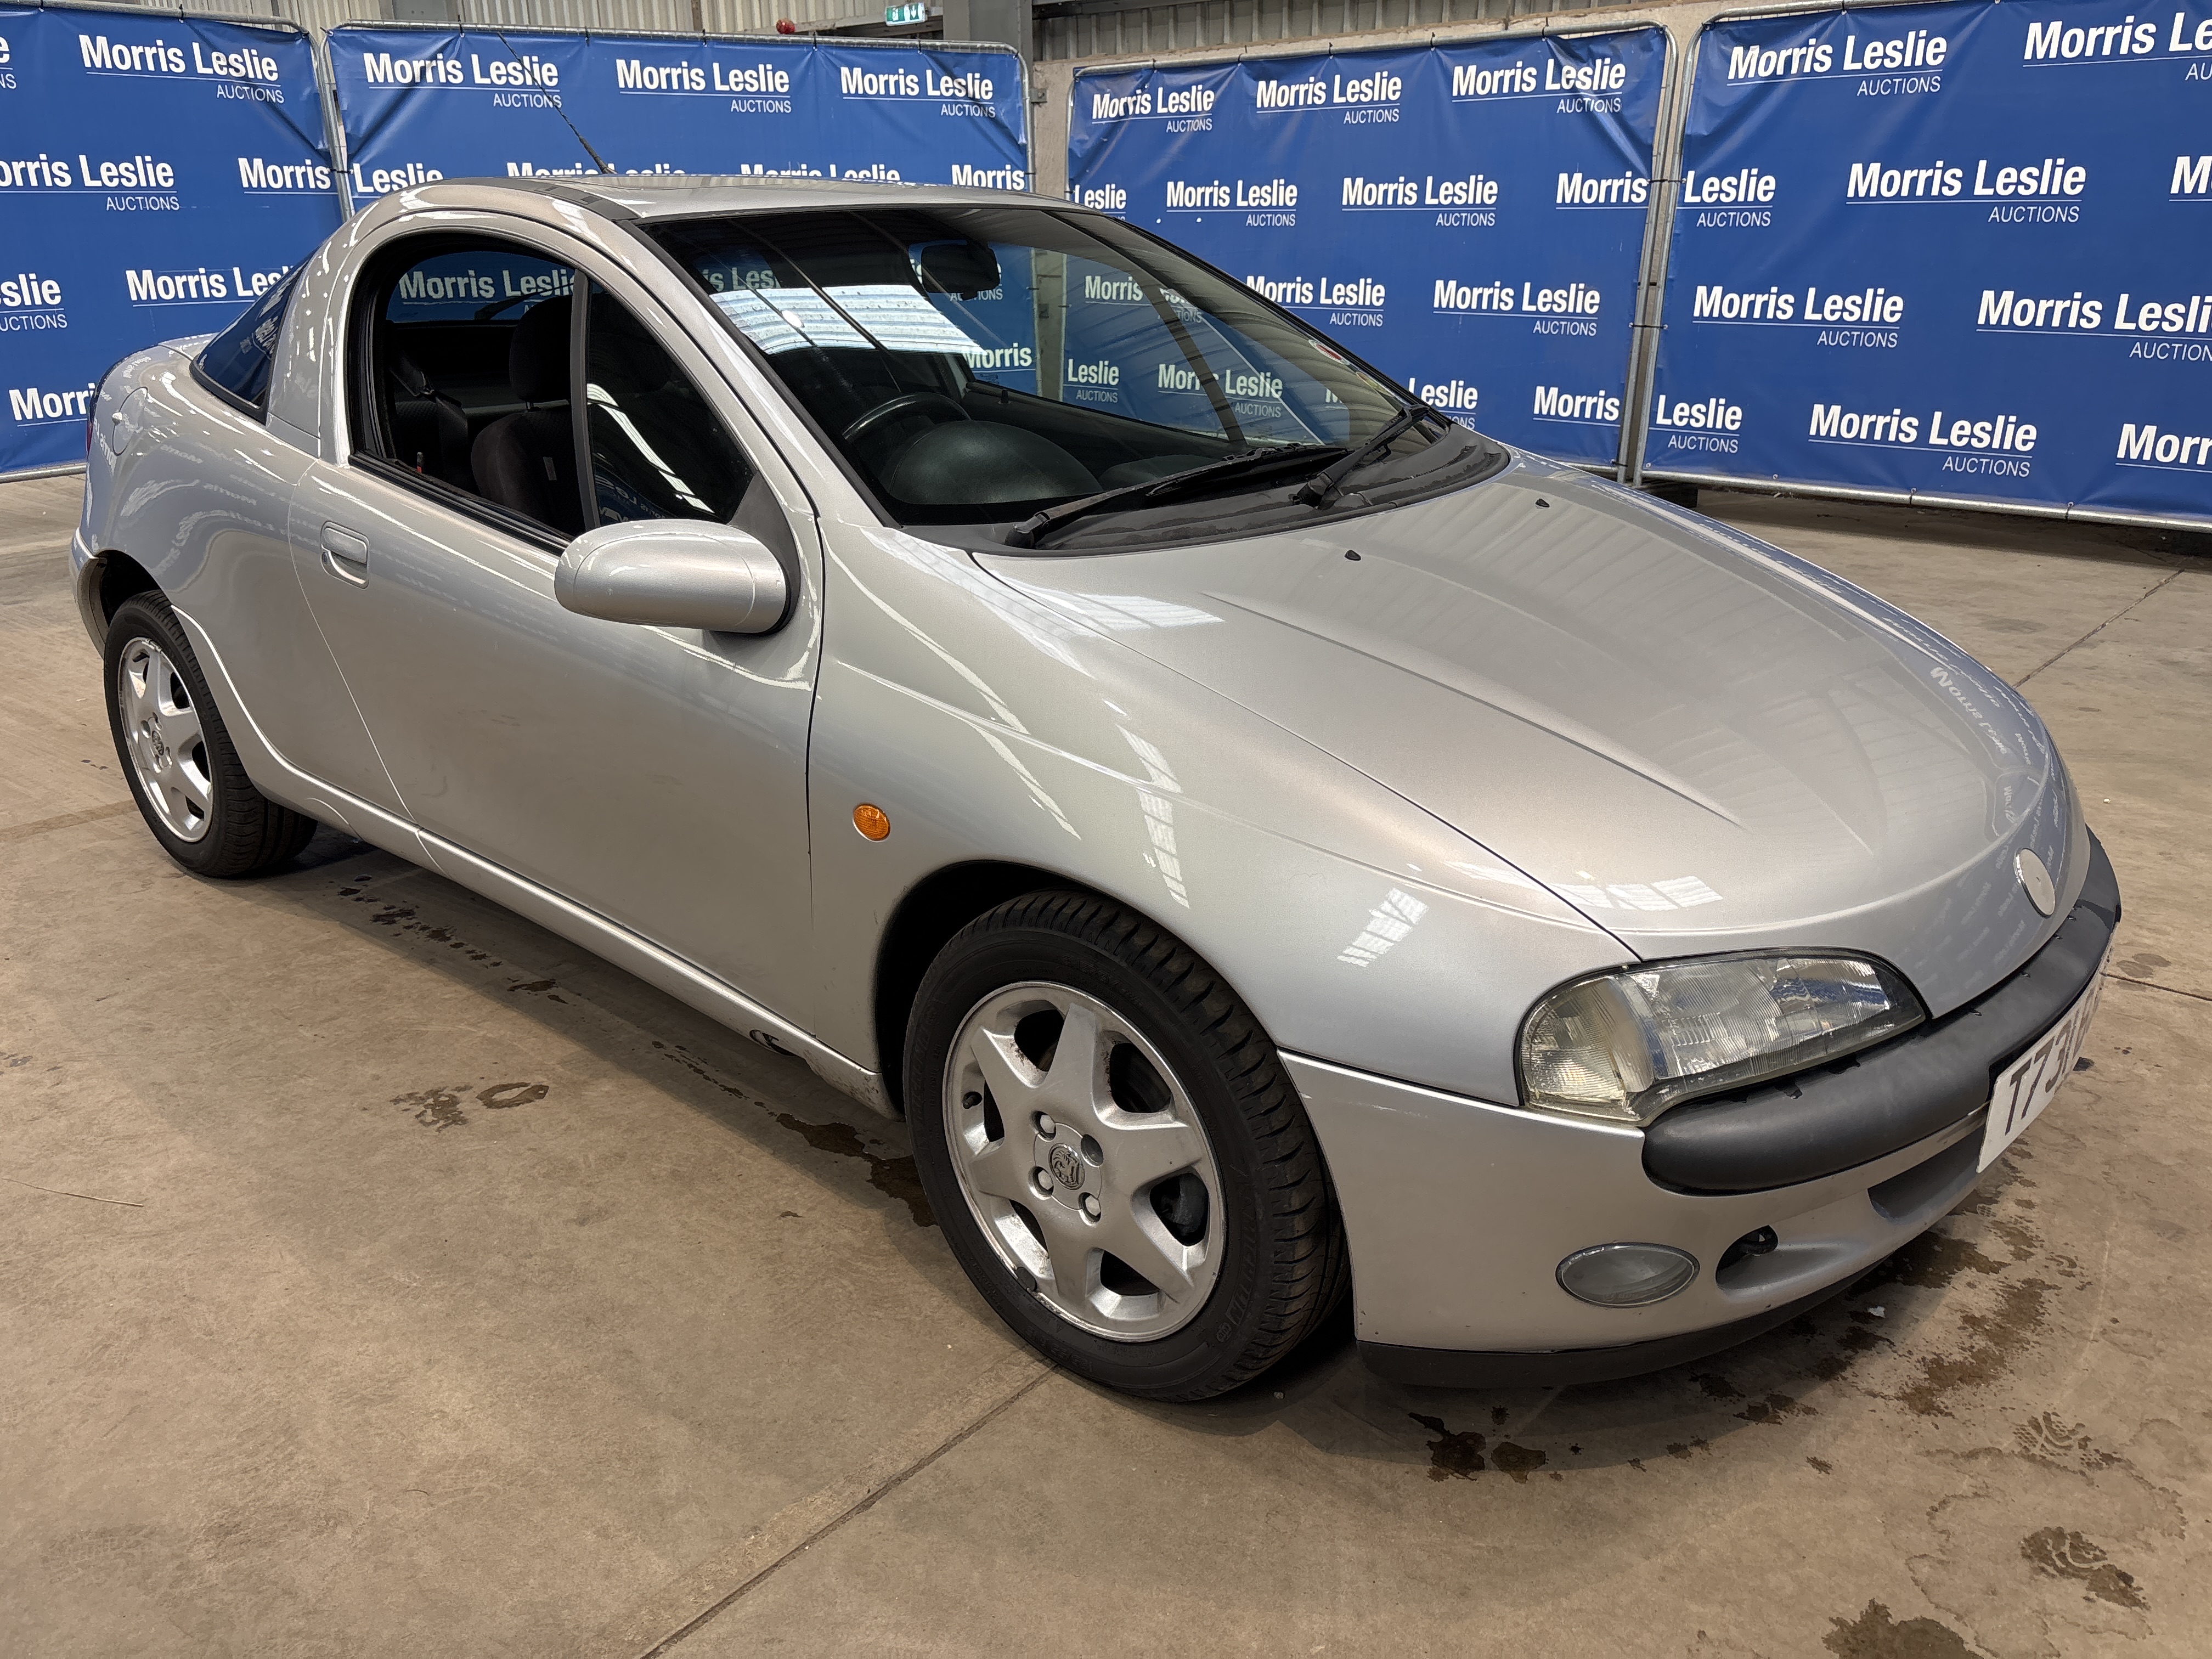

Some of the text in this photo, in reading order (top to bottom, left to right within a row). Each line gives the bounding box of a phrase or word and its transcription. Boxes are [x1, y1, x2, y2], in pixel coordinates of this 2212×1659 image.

[2024, 15, 2157, 60] Morris
[78, 34, 278, 81] Morris Leslie
[363, 53, 558, 86] Morris Leslie
[1728, 30, 1947, 80] Morris Leslie
[616, 59, 789, 93] Morris Leslie
[840, 66, 993, 100] Morris Leslie
[1256, 71, 1402, 108] Morris Leslie
[1452, 57, 1626, 97] Morris Leslie
[1857, 76, 1941, 97] AUCTIONS
[217, 84, 285, 104] AUCTIONS
[493, 93, 562, 108] AUCTIONS
[730, 99, 792, 114] AUCTIONS
[1092, 84, 1215, 120] Morris Leslie
[1556, 97, 1621, 114] AUCTIONS
[940, 101, 996, 118] AUCTIONS
[1343, 108, 1400, 125] AUCTIONS
[1166, 118, 1212, 133] AUCTIONS
[0, 153, 174, 188] orris Leslie
[238, 157, 330, 189] Morris
[952, 165, 1025, 190] Morris
[1847, 157, 2086, 198] Morris Leslie
[1166, 178, 1298, 207] Morris Leslie
[1342, 174, 1498, 206] Morris Leslie
[1556, 171, 1647, 204] Morris
[1684, 168, 1775, 203] Leslie
[106, 196, 180, 211] AUCTIONS
[1988, 206, 2080, 223] AUCTIONS
[1245, 213, 1296, 227] AUCTIONS
[1435, 212, 1496, 227] AUCTIONS
[1696, 211, 1771, 227] AUCTIONS
[0, 273, 61, 307] slie
[125, 267, 227, 301] Morris
[398, 270, 495, 298] Morris
[950, 289, 1003, 301] AUIONS
[1085, 275, 1143, 301] Morris
[1319, 277, 1385, 307] Leslie
[1433, 280, 1600, 314] Morris Leslie
[1693, 285, 1904, 323] Morris Leslie
[1977, 290, 2212, 333] Morris Lesli
[0, 314, 67, 331] UCTIONS
[1329, 312, 1383, 327] AUCTIONS
[1533, 320, 1597, 336] AUCTIONS
[1816, 330, 1898, 348] AUCTIONS
[2129, 342, 2212, 362] AUCTION
[1068, 358, 1119, 385] Leslie
[1225, 369, 1283, 398] Leslie
[9, 382, 95, 421] Morr
[1076, 389, 1118, 403] AUCTIONS
[1235, 403, 1281, 418] AUCTIONS
[1533, 386, 1620, 421] Morris
[1656, 394, 1742, 431] Leslie
[1809, 403, 2037, 452] Morris Leslie
[1667, 435, 1739, 454] AUCTIONS
[2117, 423, 2212, 465] Morr
[1942, 456, 2030, 477] AUCTIONS
